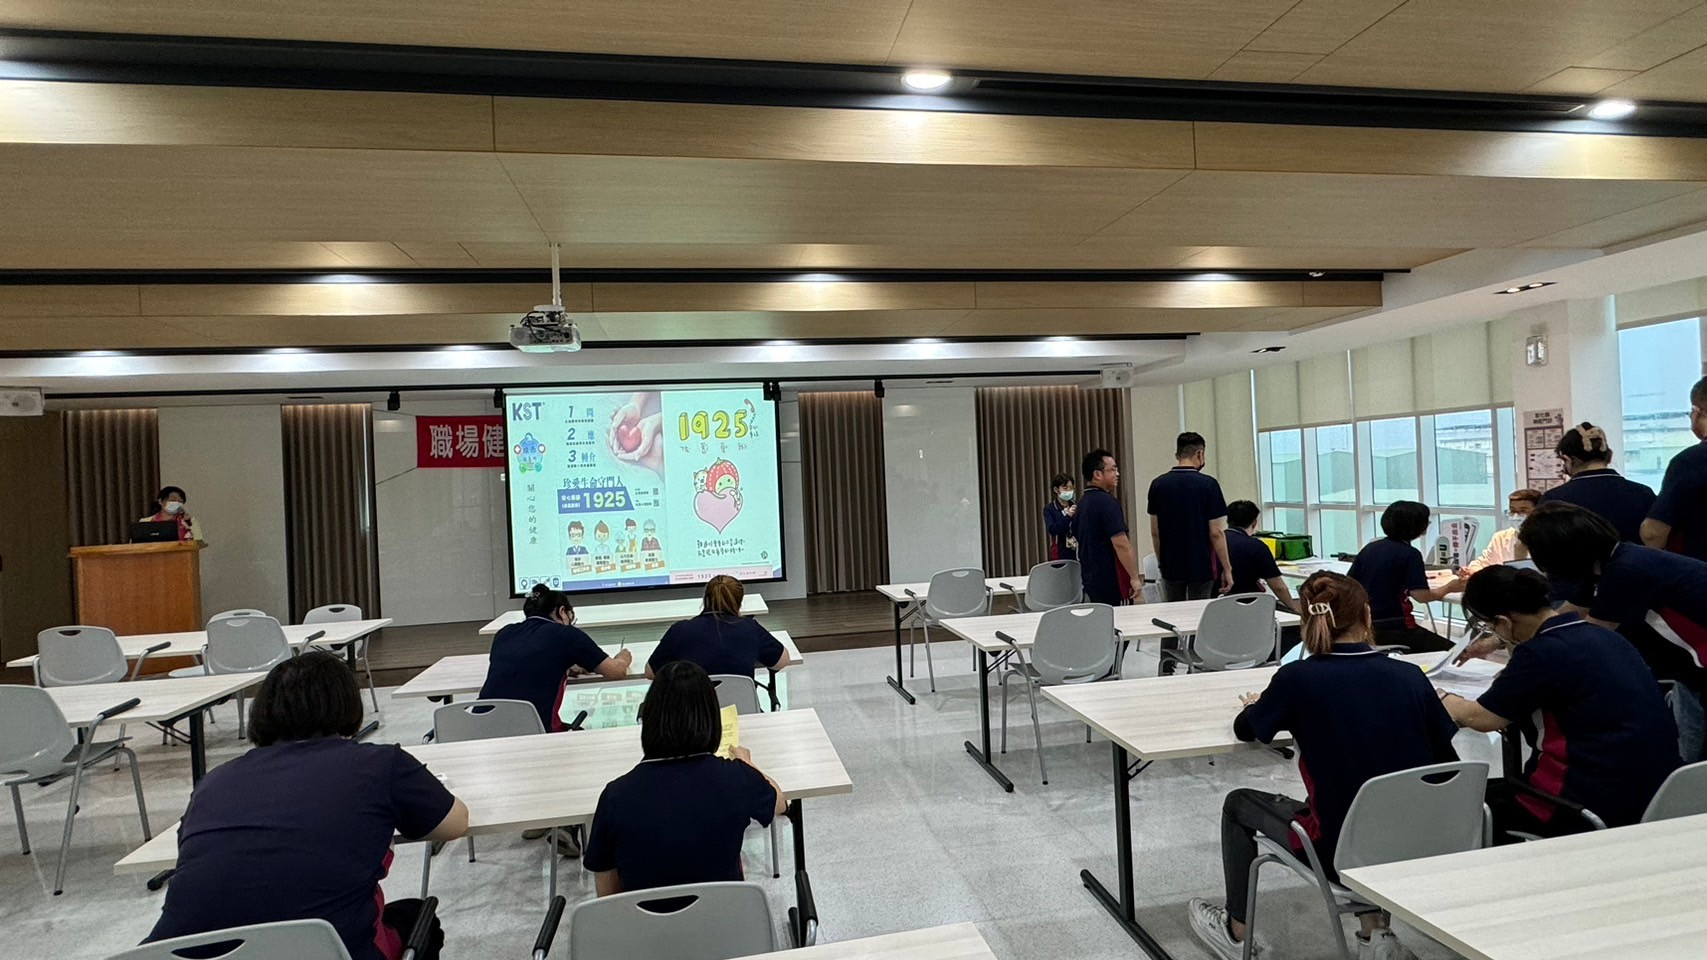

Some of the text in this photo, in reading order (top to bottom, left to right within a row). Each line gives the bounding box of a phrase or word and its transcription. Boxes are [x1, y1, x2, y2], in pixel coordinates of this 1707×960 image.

[512, 402, 541, 421] KST
[567, 427, 576, 441] 2
[678, 409, 749, 441] 1925
[429, 424, 504, 458] 職場健
[568, 449, 577, 463] 3
[563, 476, 624, 489] 珍愛生命守門人
[583, 491, 626, 509] 1925
